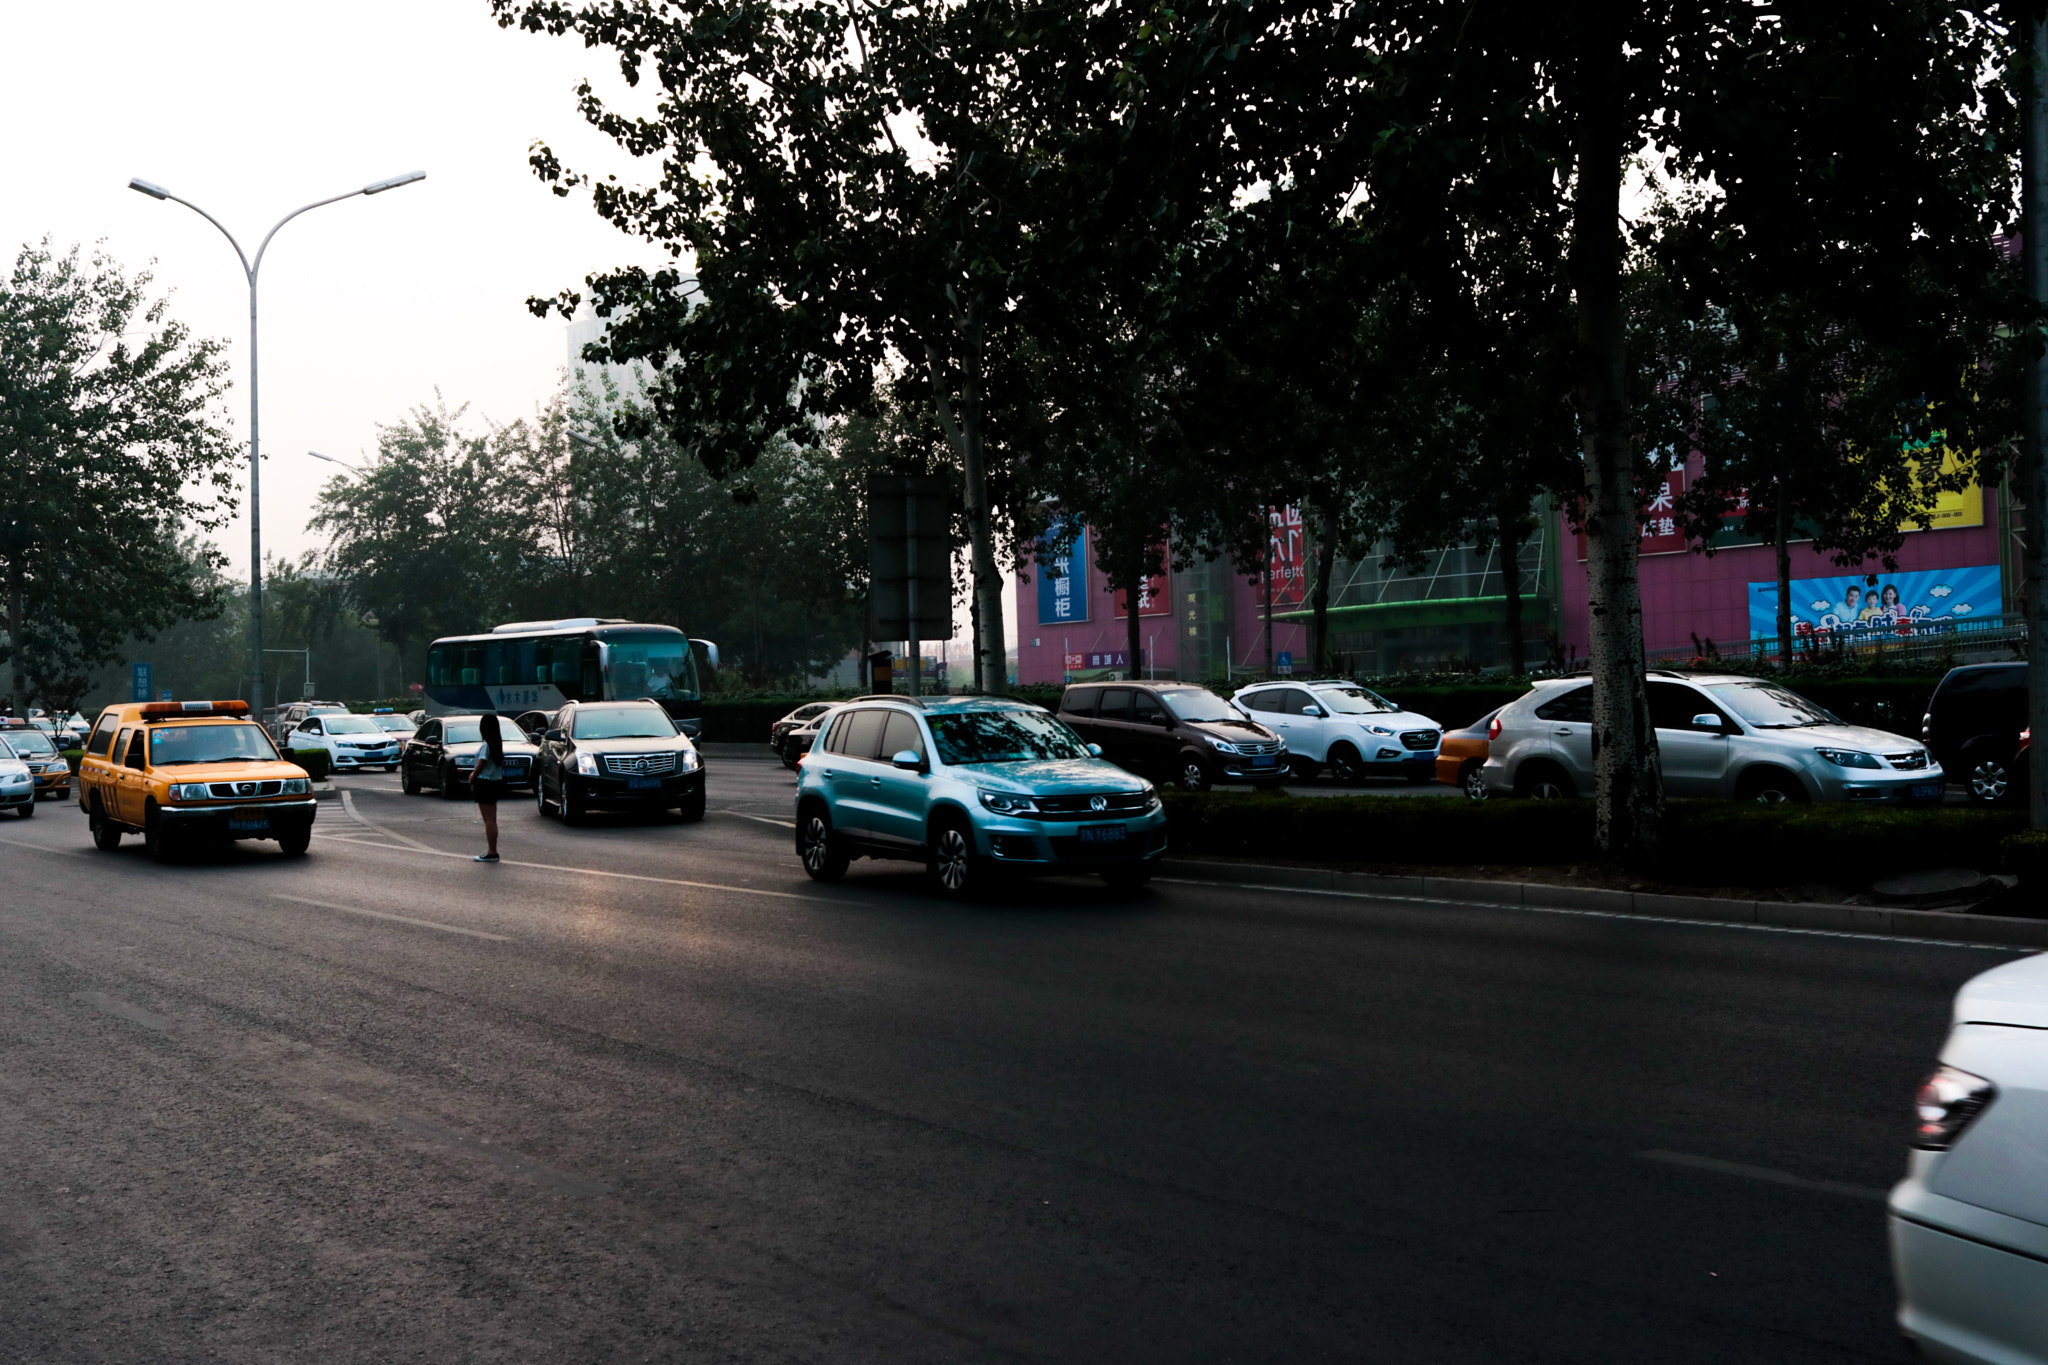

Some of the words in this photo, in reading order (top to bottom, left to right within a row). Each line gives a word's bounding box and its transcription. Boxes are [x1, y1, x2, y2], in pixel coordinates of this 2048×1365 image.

[1054, 535, 1071, 617] 米橱柜
[137, 666, 148, 699] 联想桥
